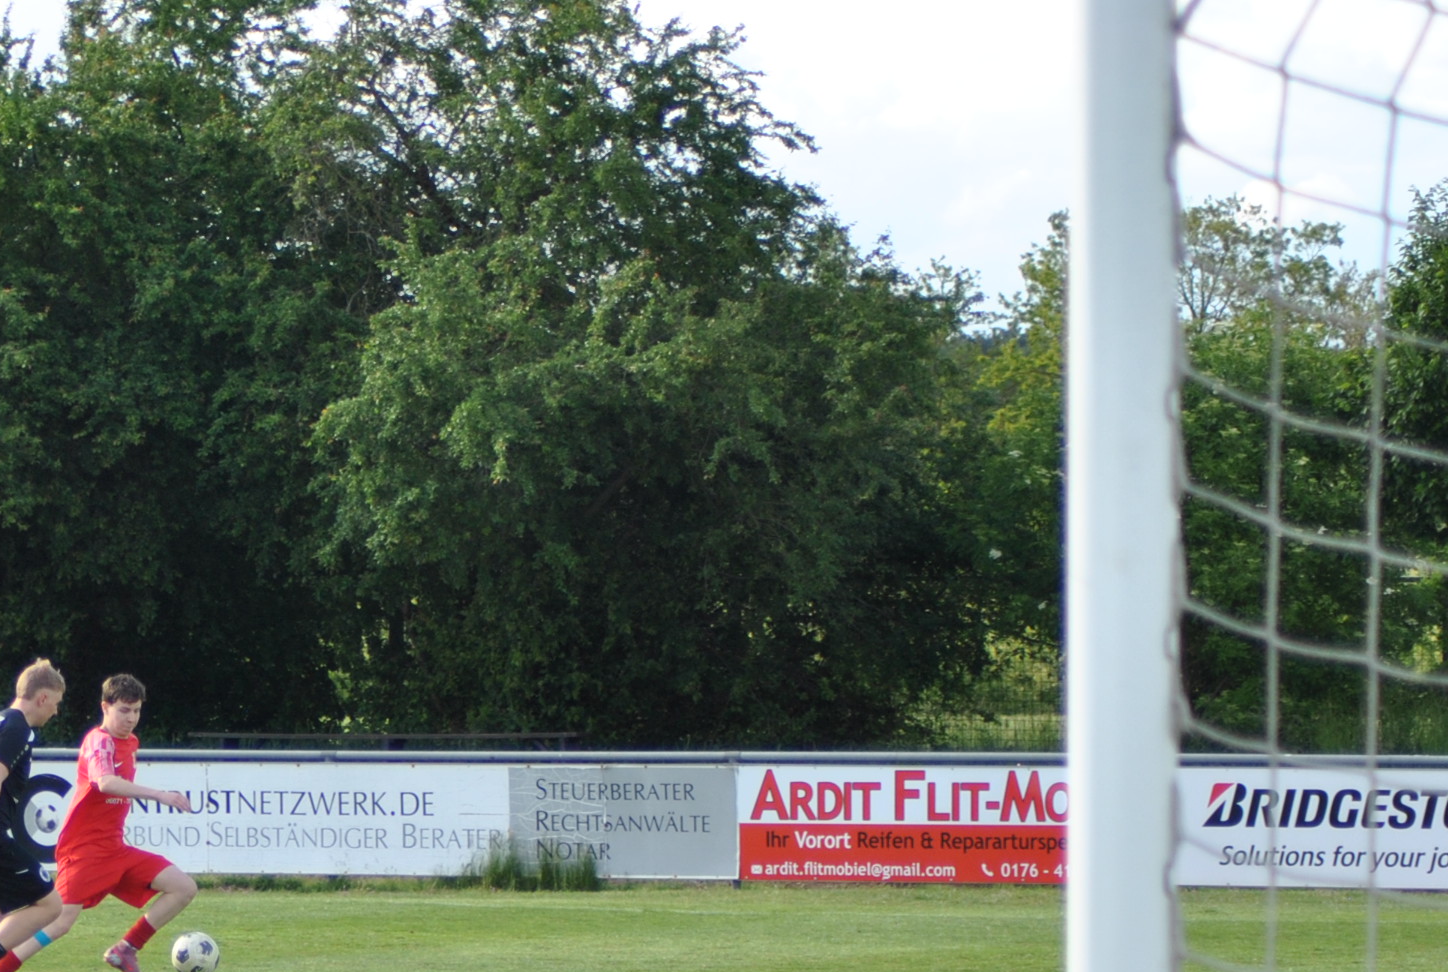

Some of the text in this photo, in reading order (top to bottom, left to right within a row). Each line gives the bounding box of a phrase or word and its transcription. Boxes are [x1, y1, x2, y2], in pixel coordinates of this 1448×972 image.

[536, 778, 695, 801] STEUERBERATER
[750, 768, 882, 821] ARDIT
[1202, 782, 1448, 829] BRIDGEST
[536, 810, 711, 833] RECHTSANWÄLTE
[209, 821, 389, 849] SELBSTÄNDIGER
[402, 823, 501, 850] BERATER
[766, 831, 789, 848] Ihr
[794, 831, 851, 849] Vorort
[858, 831, 914, 848] Reifen
[921, 832, 933, 848] &
[536, 838, 611, 860] NOTAR
[1219, 845, 1325, 866] Solutions
[1332, 846, 1367, 867] for
[1369, 851, 1425, 873] your
[765, 862, 956, 880] ardit.flitmobiel@gmail.com
[1001, 862, 1038, 877] 0176
